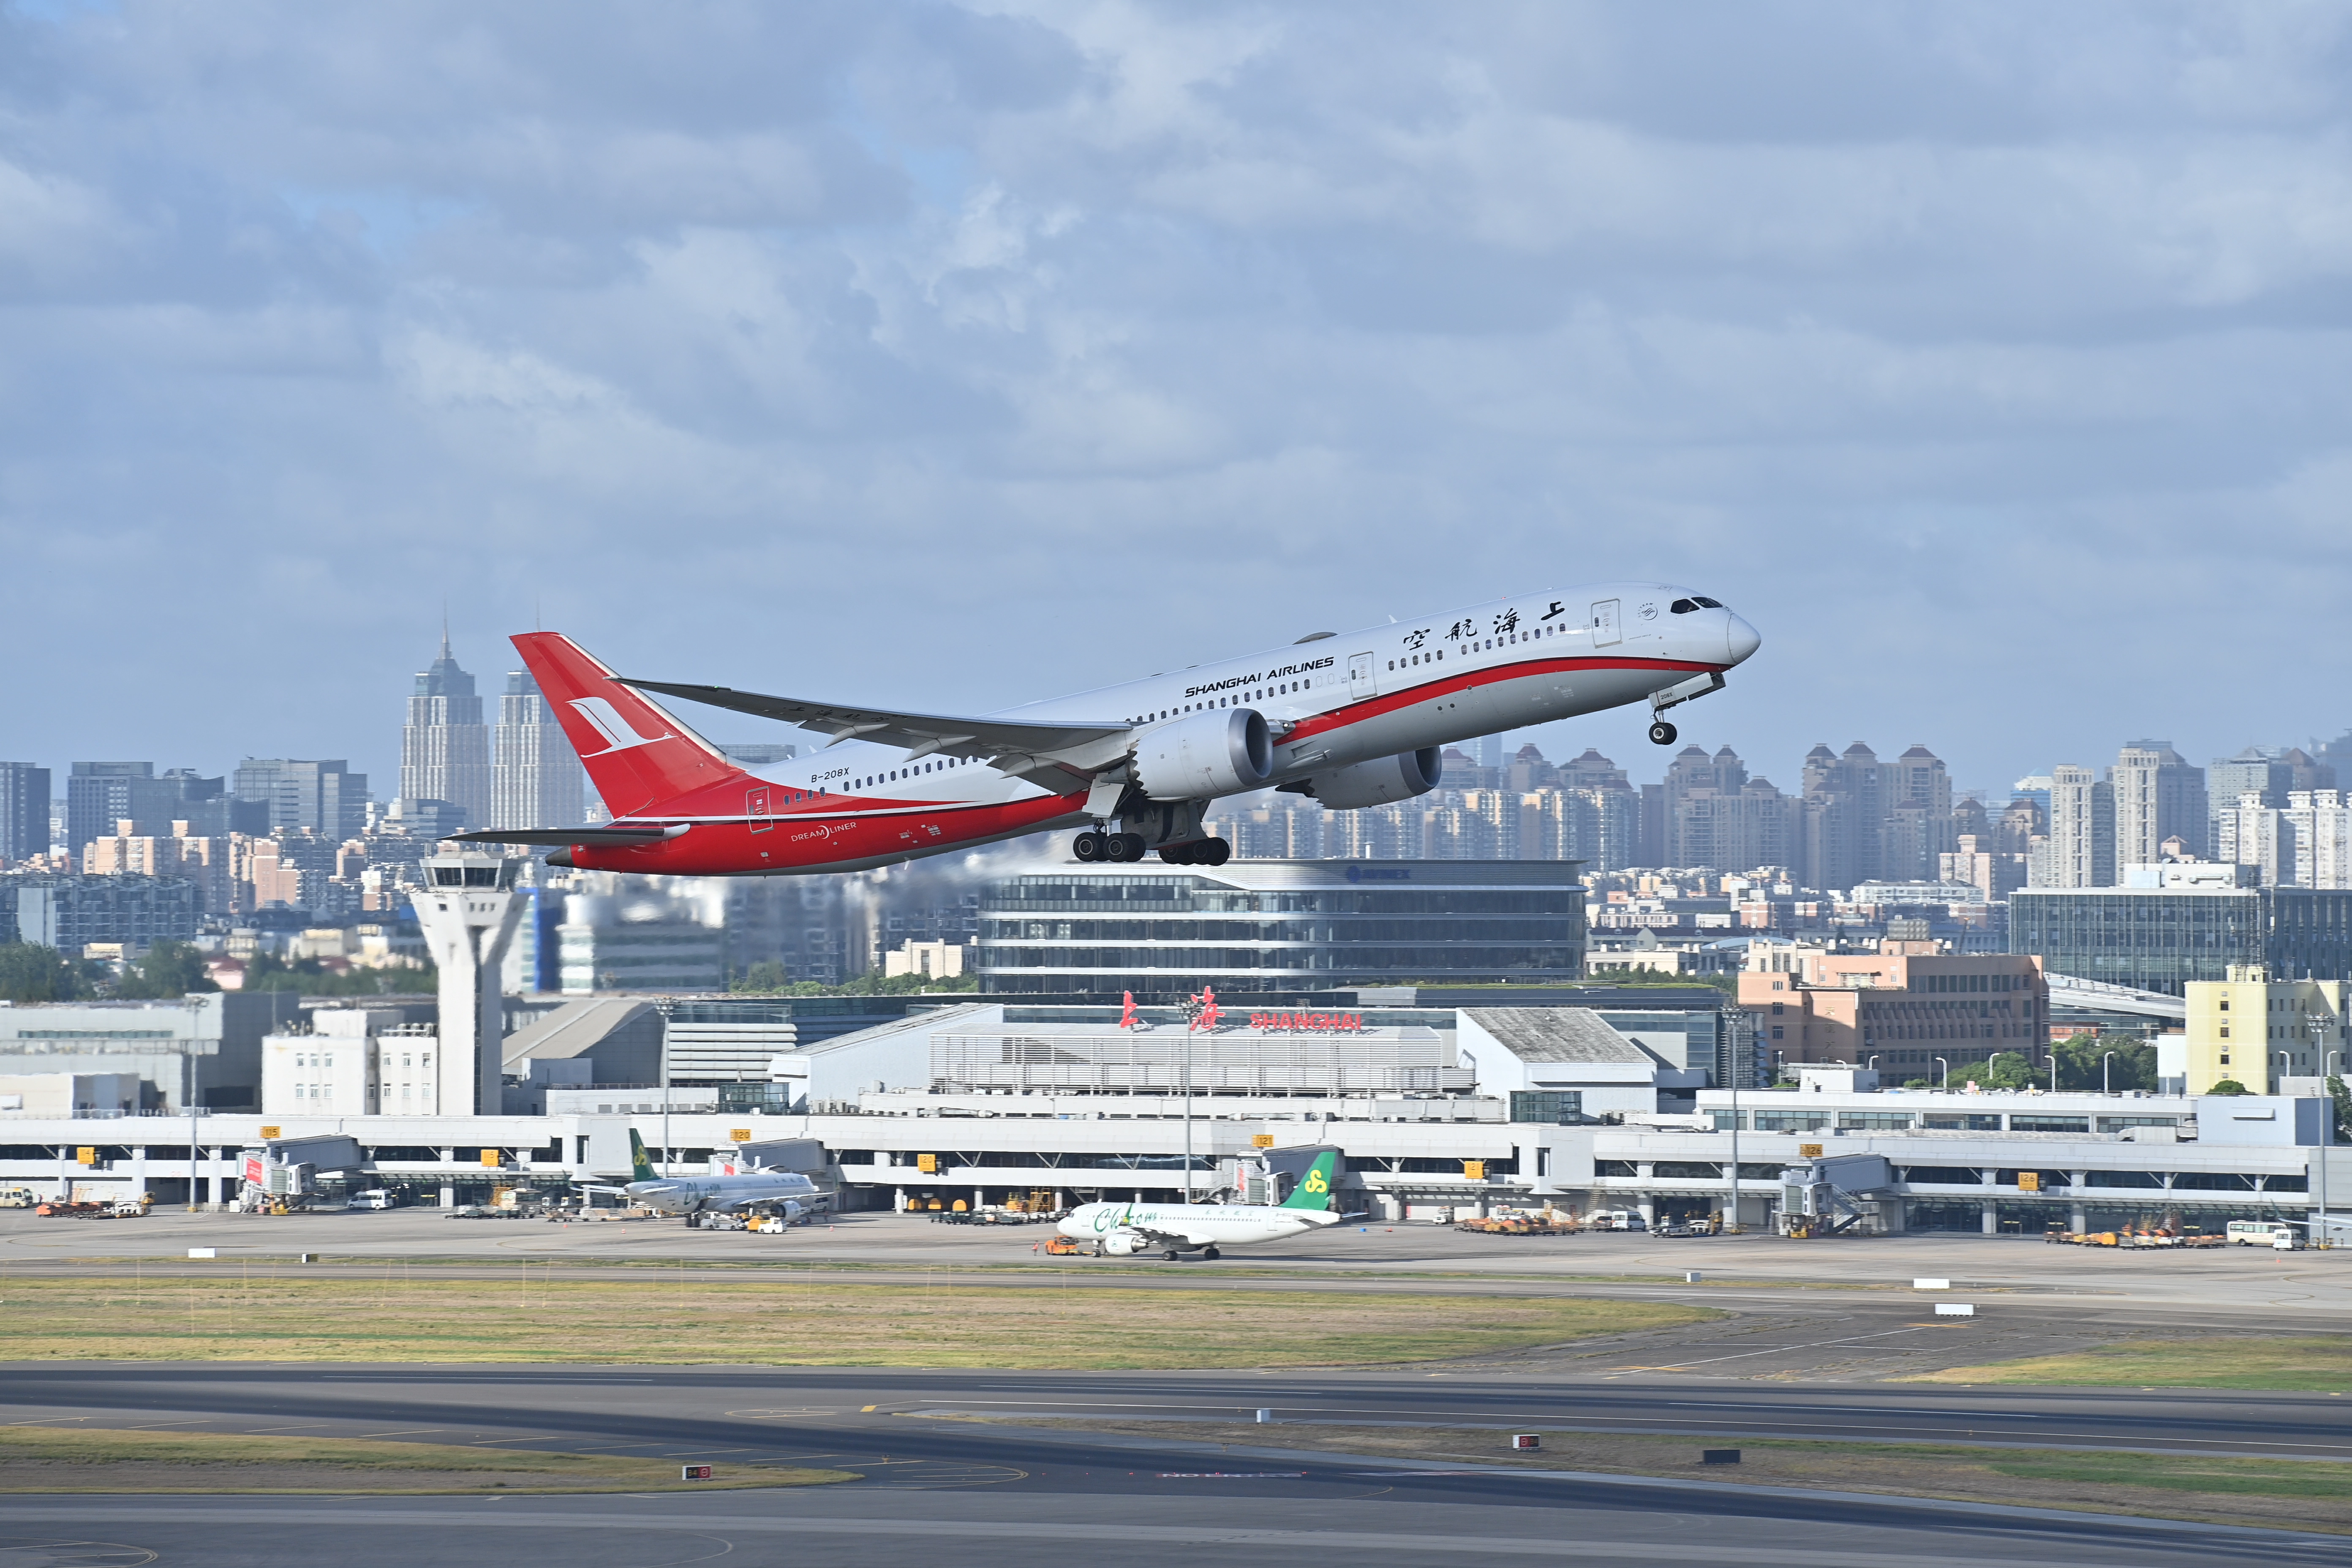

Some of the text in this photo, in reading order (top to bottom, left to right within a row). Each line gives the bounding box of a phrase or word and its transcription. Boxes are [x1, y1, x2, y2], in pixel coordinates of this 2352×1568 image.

[1184, 656, 1334, 697] SHANGHAI AIRLINES
[811, 767, 849, 783] B-208X
[1119, 985, 1226, 1032] 上海
[1250, 1013, 1361, 1030] SHANGHAI
